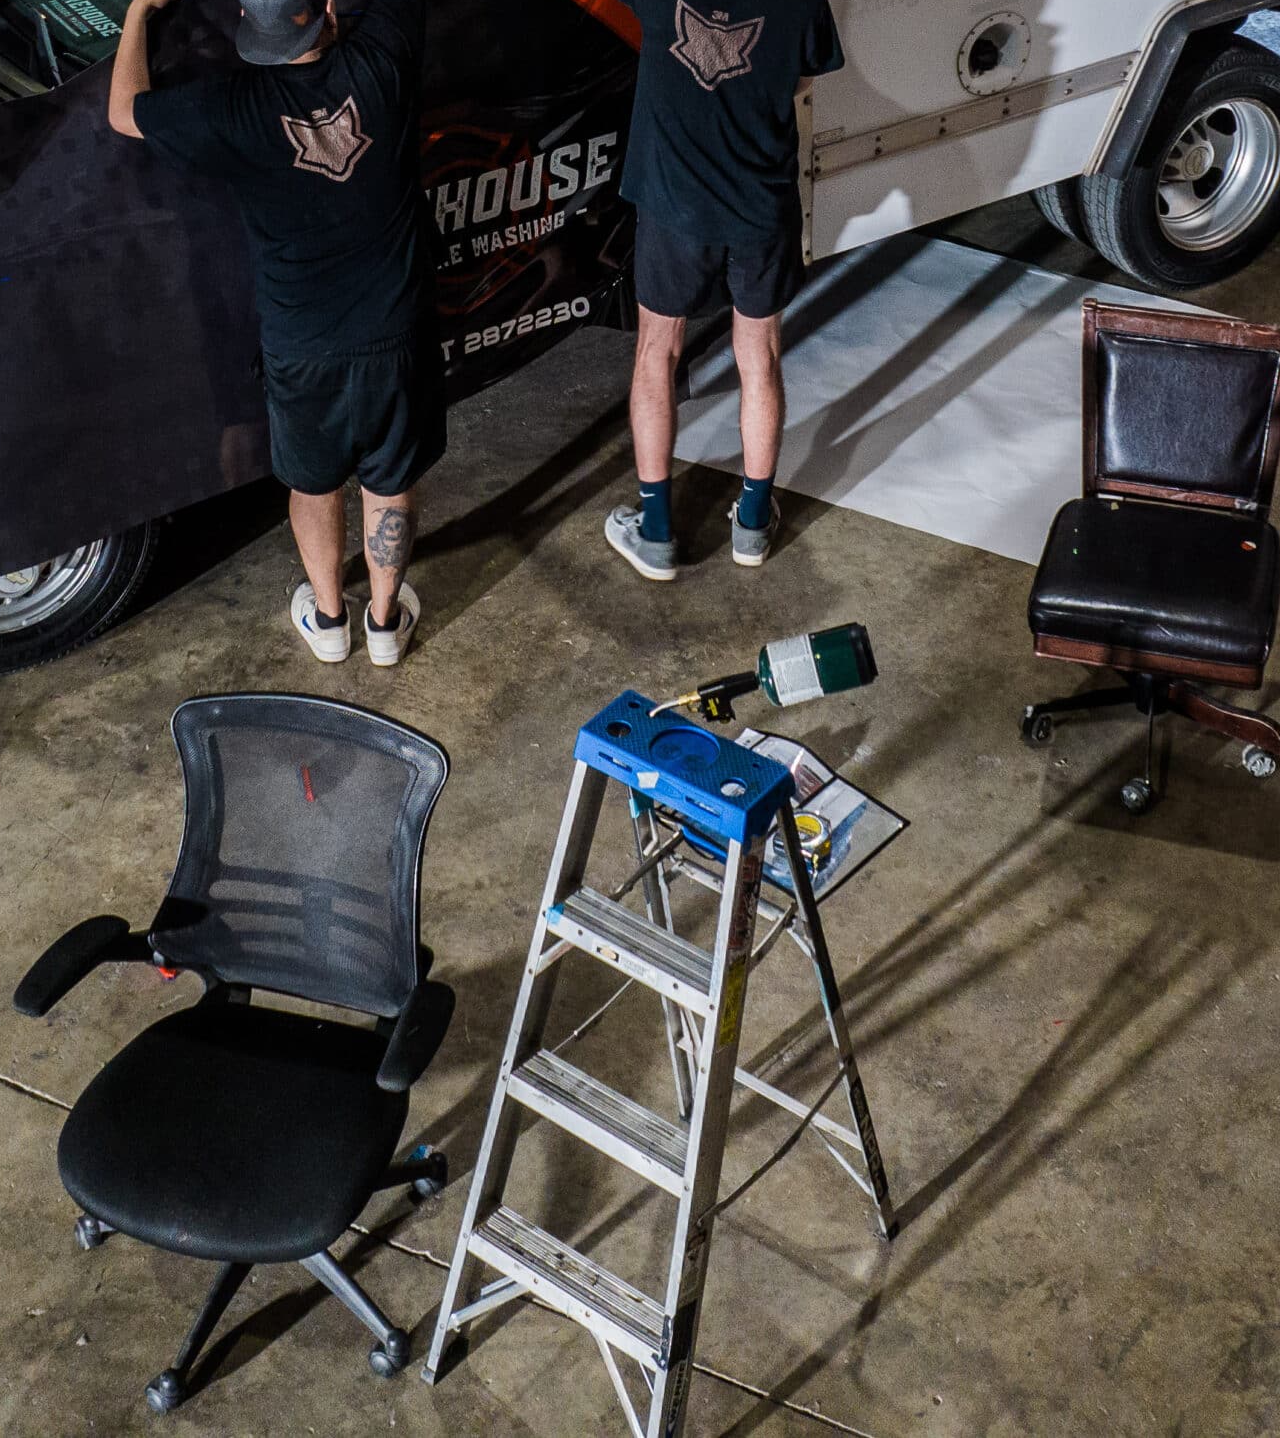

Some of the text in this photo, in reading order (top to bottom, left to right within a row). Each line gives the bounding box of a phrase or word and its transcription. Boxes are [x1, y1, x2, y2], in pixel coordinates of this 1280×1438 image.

[711, 10, 729, 22] 3M
[312, 107, 329, 119] 3M
[426, 131, 618, 236] HOUSE
[471, 210, 566, 257] WASHING
[464, 296, 591, 355] 2872230
